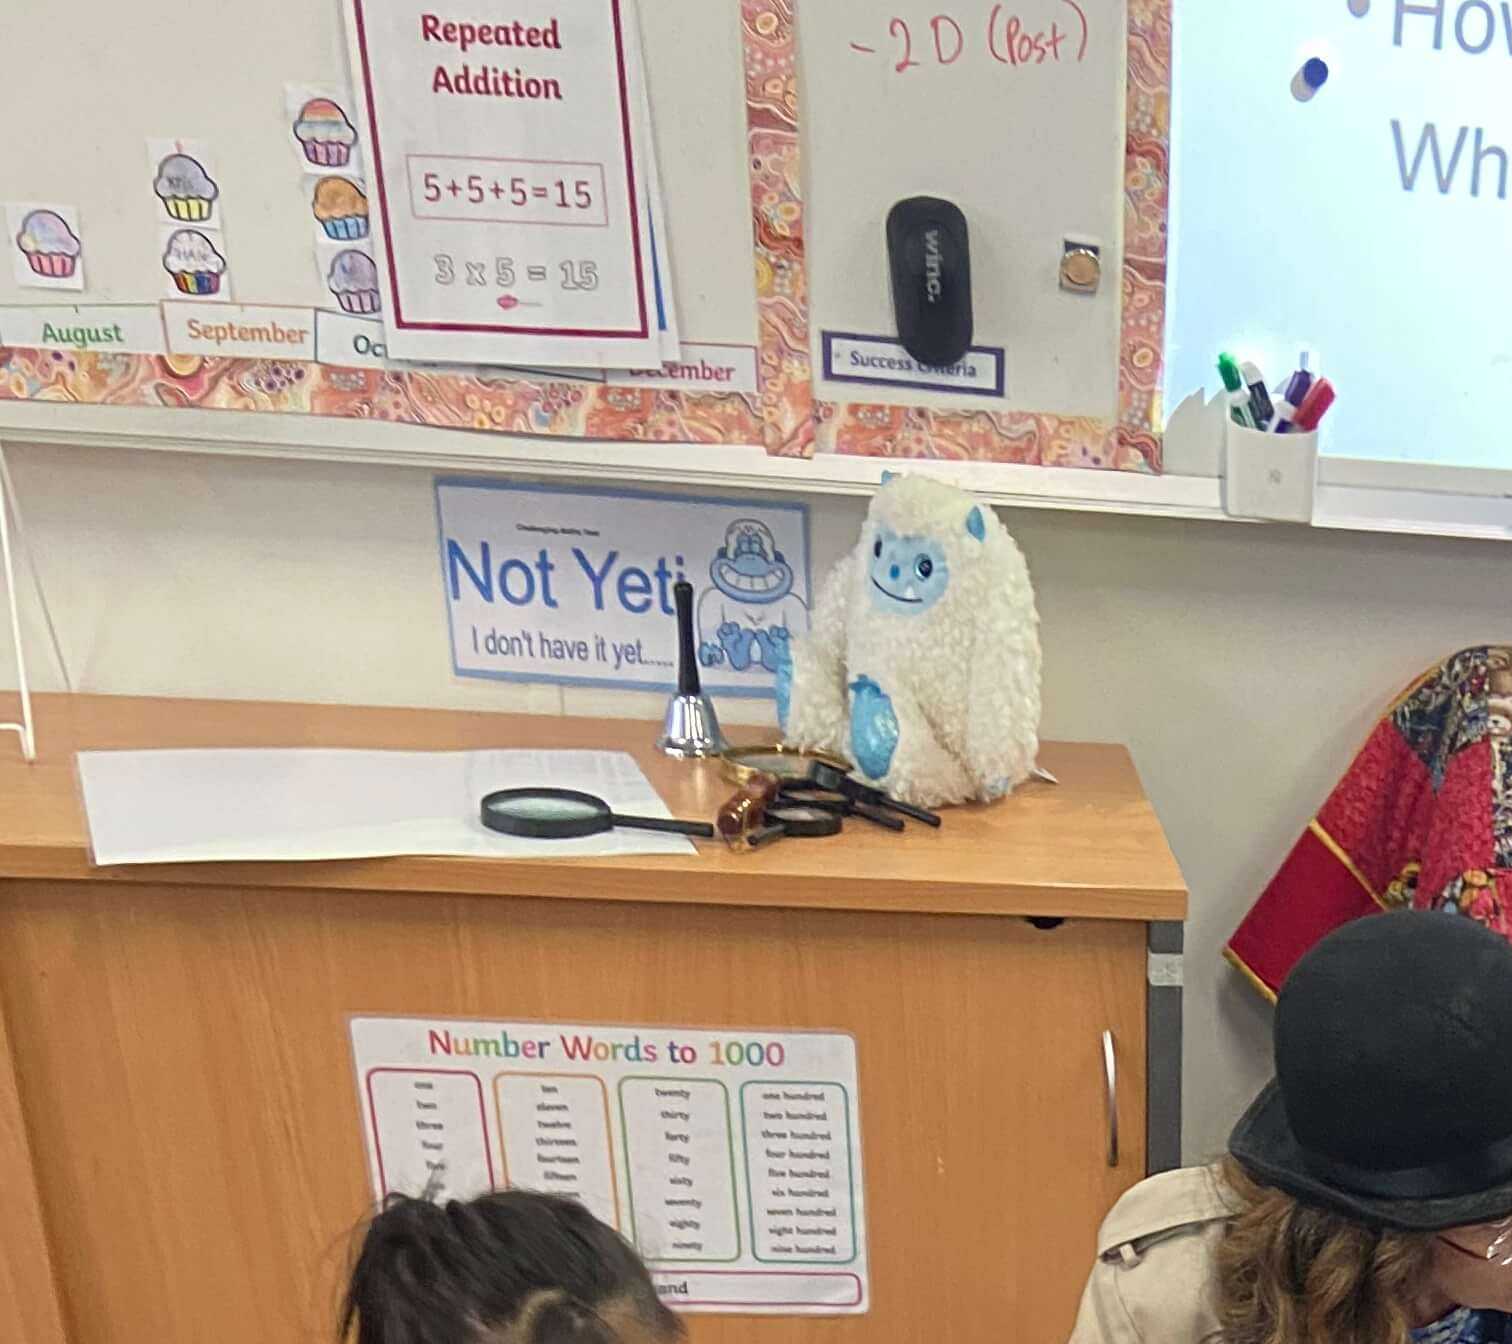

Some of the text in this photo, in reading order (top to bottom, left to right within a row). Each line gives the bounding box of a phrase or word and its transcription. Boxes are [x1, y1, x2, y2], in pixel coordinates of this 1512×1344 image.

[421, 14, 562, 52] Repeated
[432, 63, 563, 100] Addition
[424, 173, 592, 209] 5+5+5=15
[434, 254, 455, 285] 3
[496, 257, 515, 287] 5
[559, 260, 599, 291] 15
[42, 323, 124, 349] August
[187, 318, 309, 345] September
[850, 350, 913, 372] Success
[918, 361, 977, 378] eria
[447, 538, 559, 609] Not
[472, 624, 479, 654] I
[485, 627, 535, 658] don't
[539, 631, 588, 661] have
[594, 633, 607, 662] it
[429, 1030, 784, 1067] Number Words to 1000
